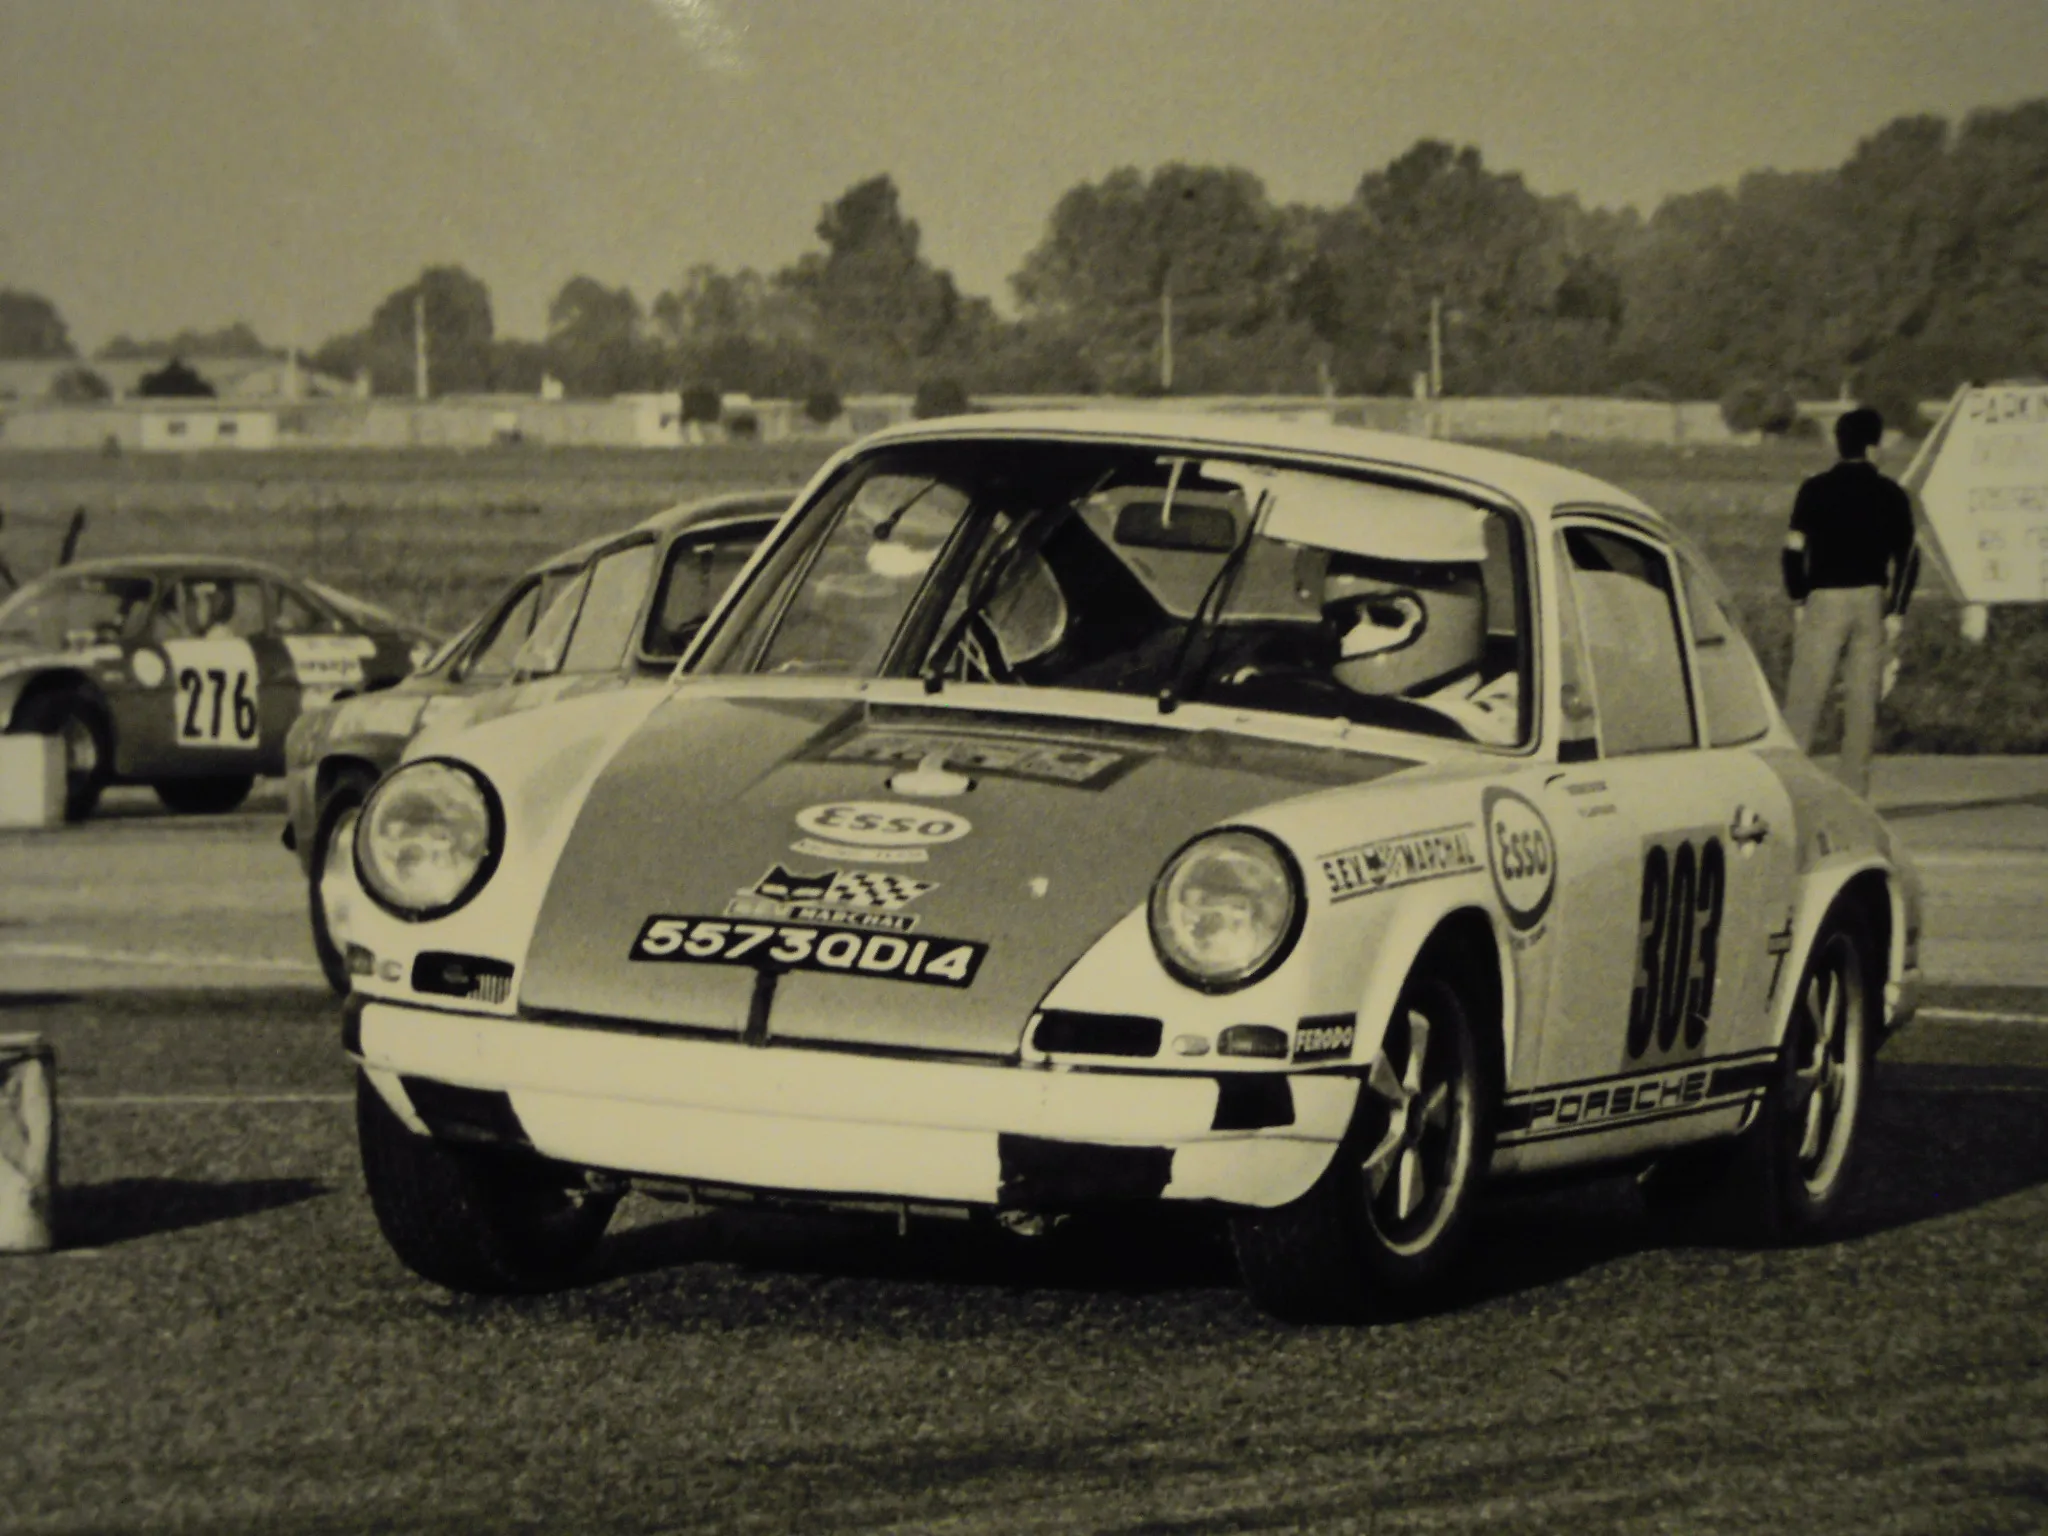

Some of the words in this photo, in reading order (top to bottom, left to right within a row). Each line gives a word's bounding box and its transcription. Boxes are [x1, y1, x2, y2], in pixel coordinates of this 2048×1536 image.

[179, 667, 256, 740] 276
[641, 919, 974, 981] 5573QD14
[1626, 836, 1725, 1060] 303
[1294, 1026, 1354, 1052] FERODO
[1525, 1070, 1709, 1134] PORSCHE
